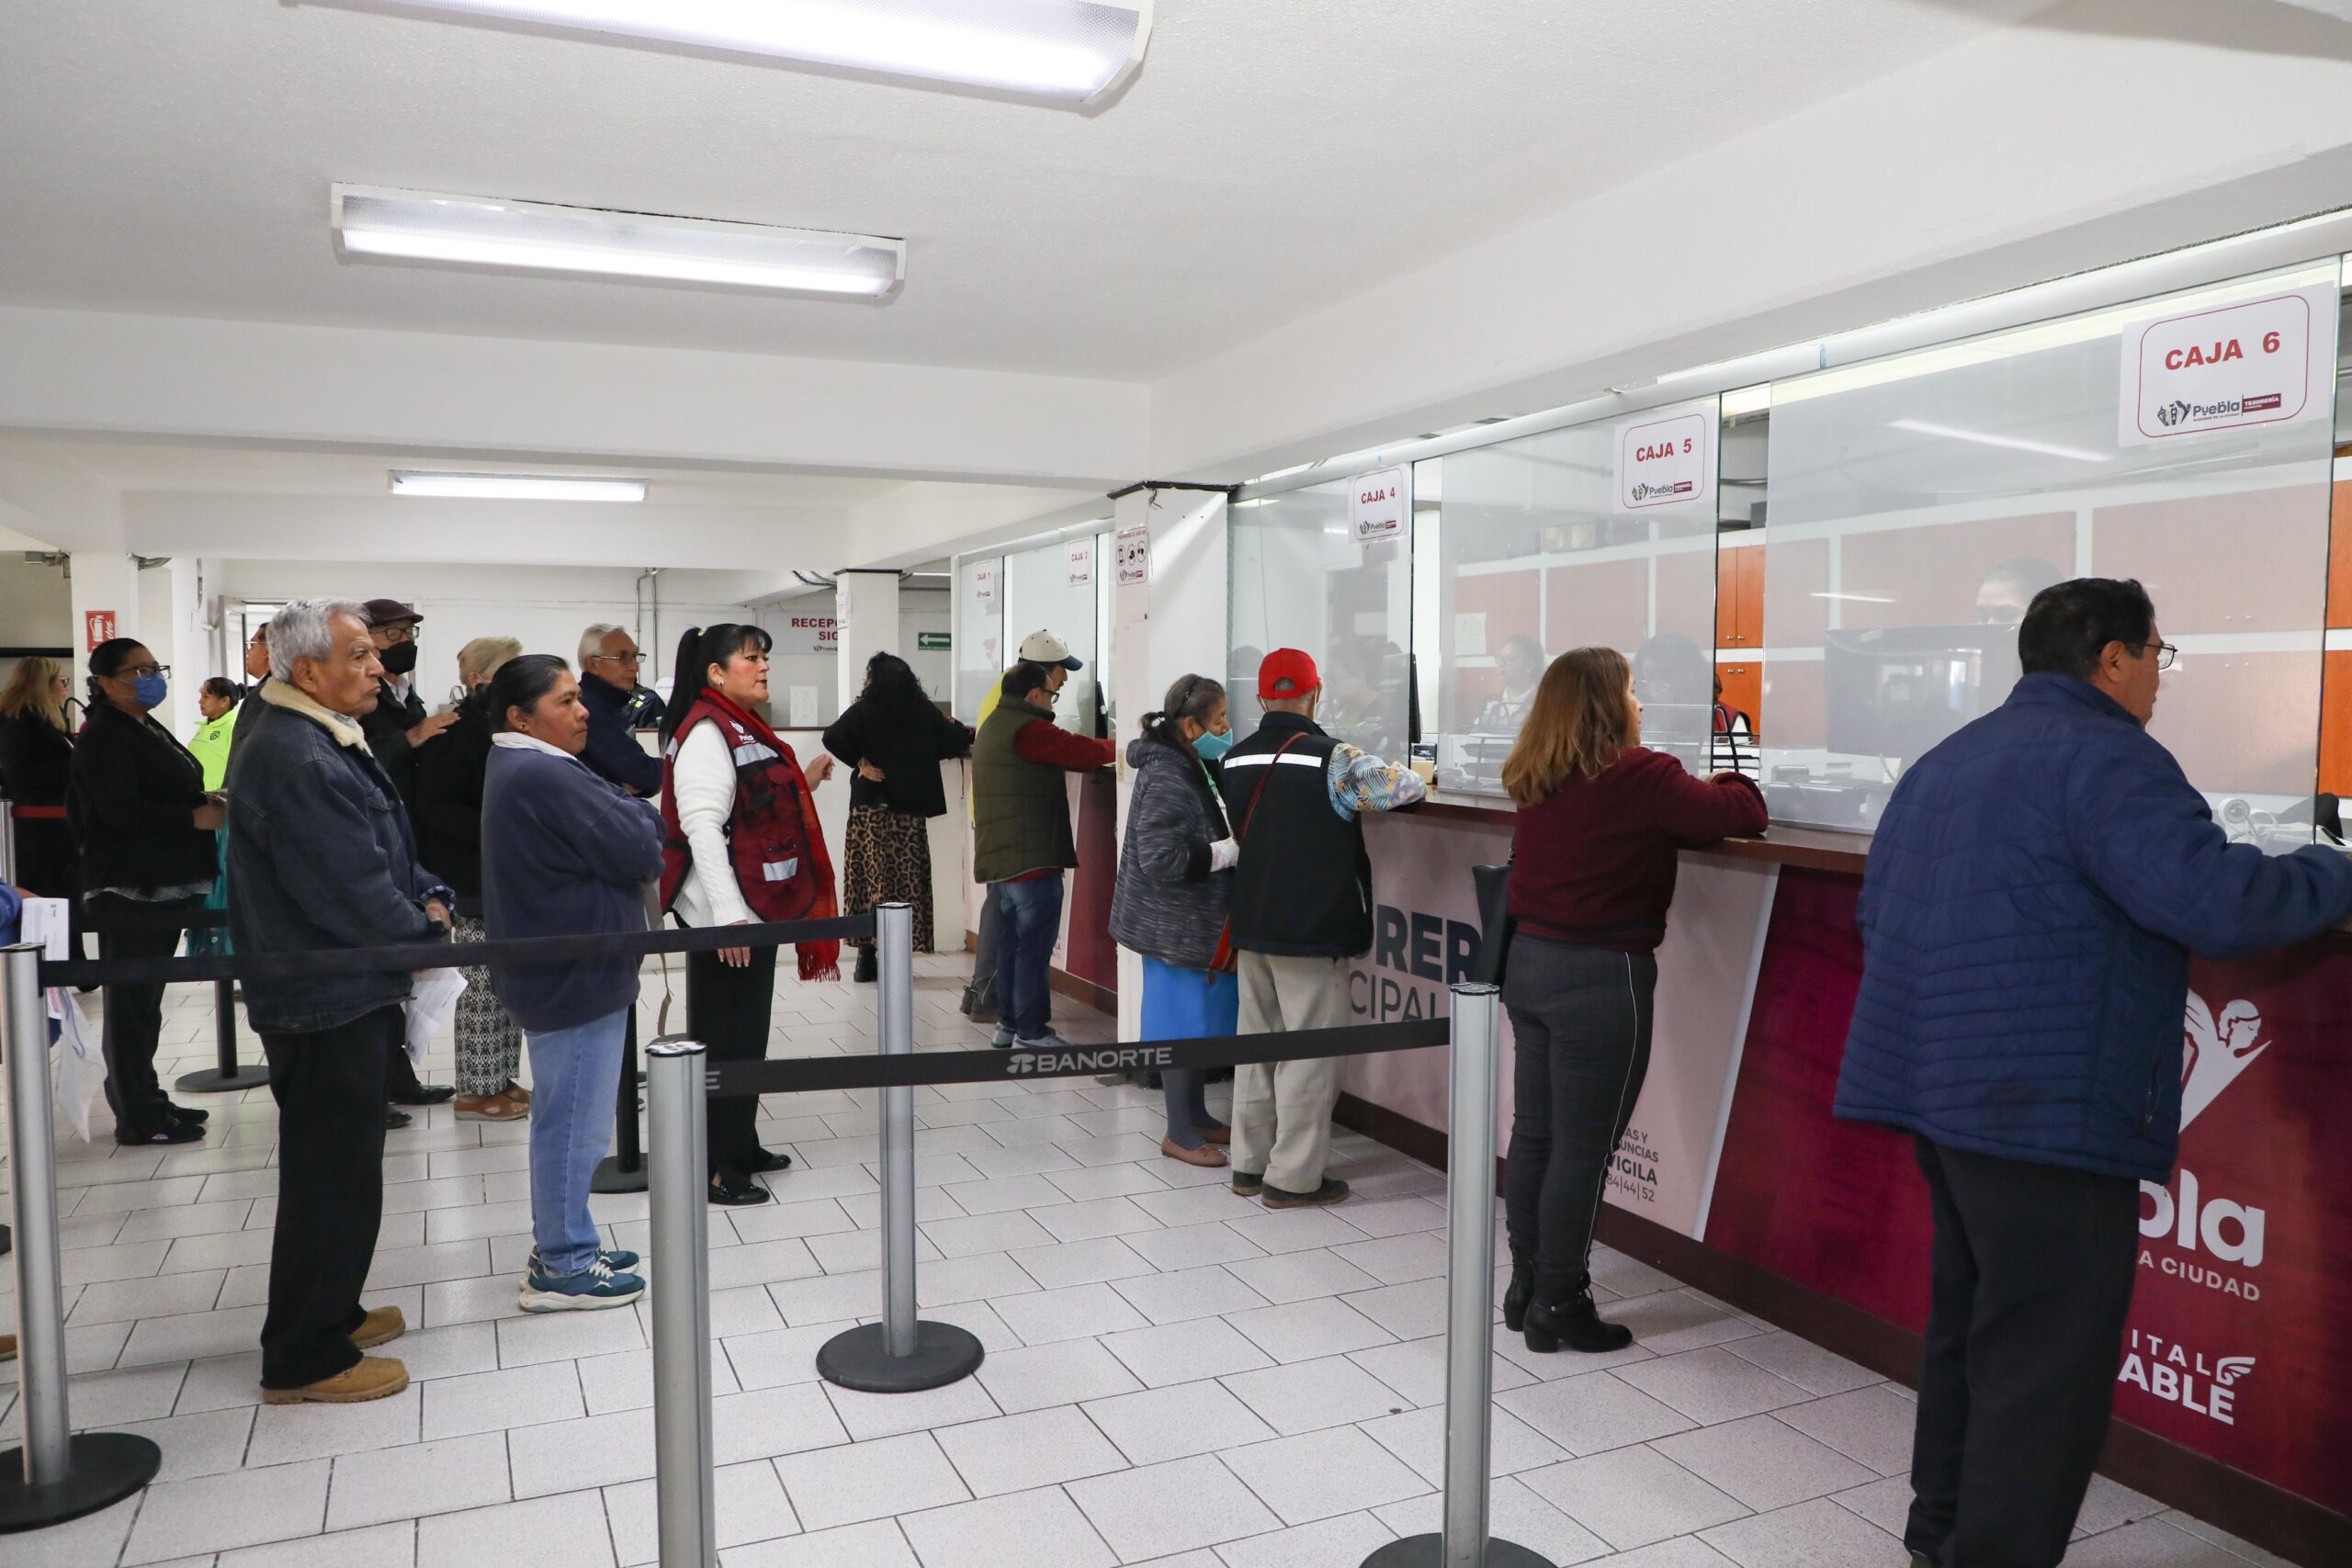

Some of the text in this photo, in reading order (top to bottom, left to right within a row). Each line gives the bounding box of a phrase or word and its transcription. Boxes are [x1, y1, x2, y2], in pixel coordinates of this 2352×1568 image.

[2165, 332, 2280, 370] CAJA 6
[2193, 400, 2240, 417] Puebla
[1636, 438, 1692, 462] CAJA 5
[1362, 486, 1396, 504] CAJA 4
[791, 617, 838, 628] RECEP
[1354, 903, 1485, 985] RER
[1036, 1046, 1172, 1073] BANORTE
[1641, 1132, 1648, 1145] Y
[2135, 1250, 2260, 1302] A CIUDAD
[2132, 1328, 2211, 1376] ITAL
[2118, 1352, 2235, 1426] ABLE
